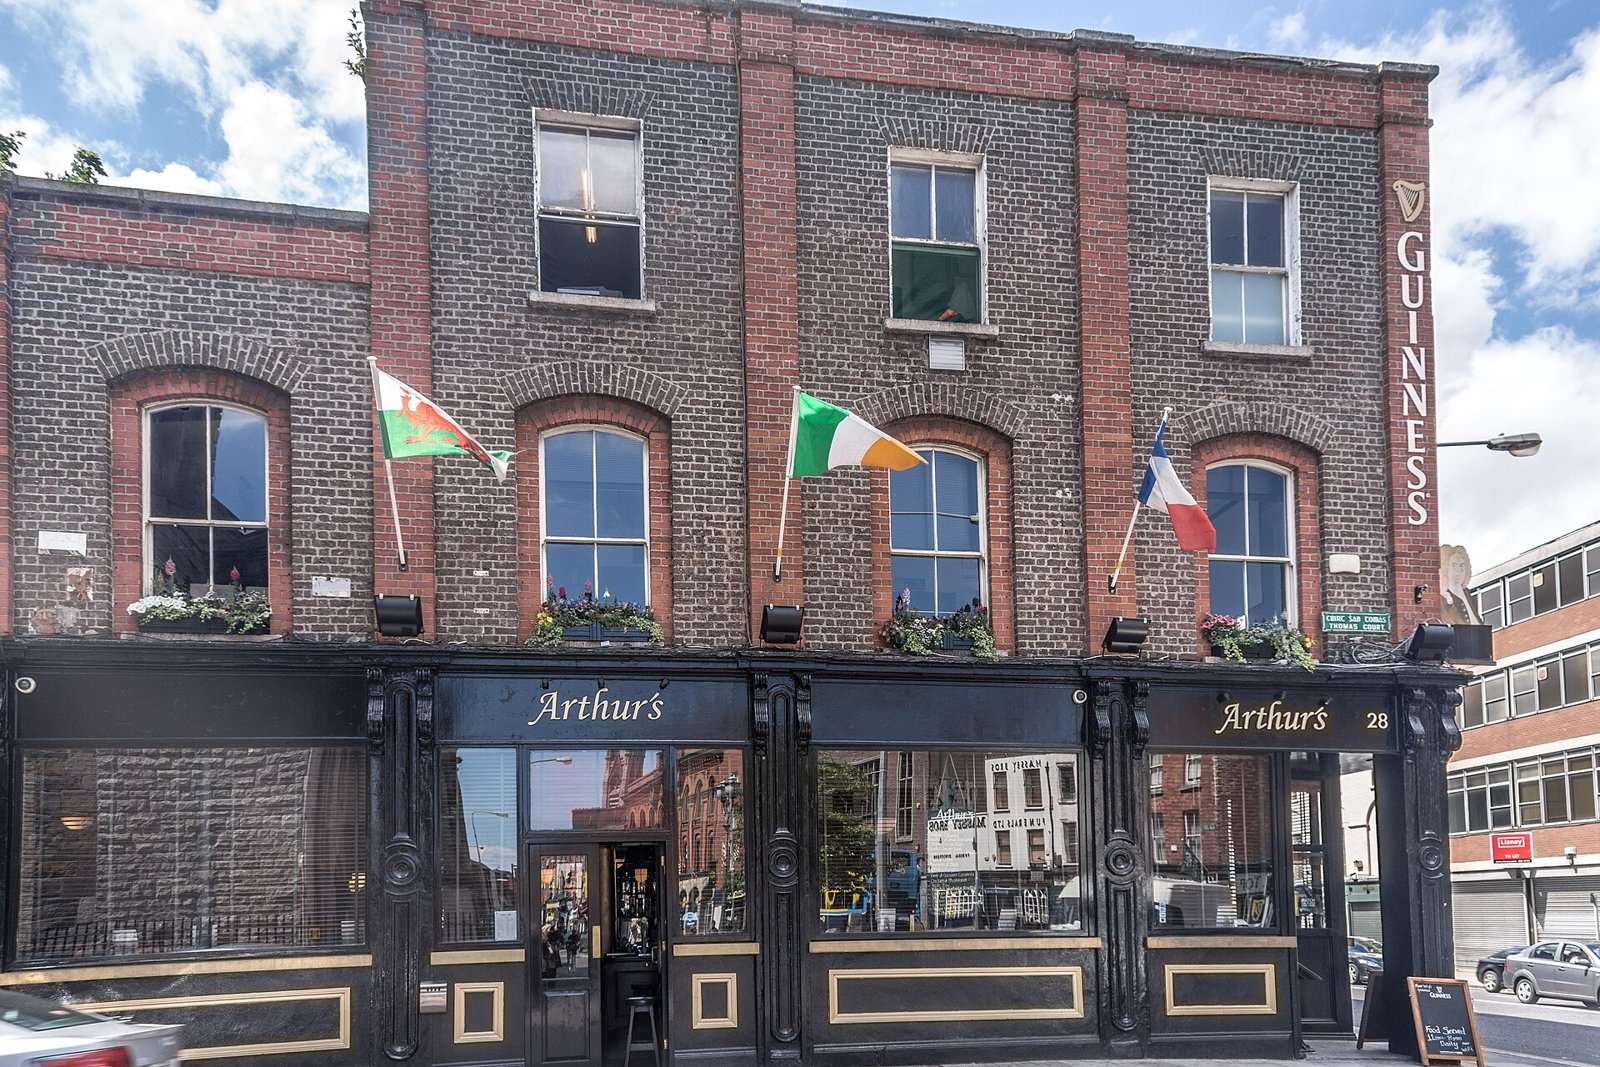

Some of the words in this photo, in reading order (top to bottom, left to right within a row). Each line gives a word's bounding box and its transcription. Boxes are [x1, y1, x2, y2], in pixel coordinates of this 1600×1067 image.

[1397, 231, 1428, 525] GUINNESS
[527, 687, 664, 726] Arthur's
[1214, 700, 1329, 734] Arthur's
[1366, 712, 1389, 729] 28
[1425, 1025, 1441, 1034] Food
[1442, 1026, 1466, 1036] Served
[1440, 1041, 1459, 1049] Daily
